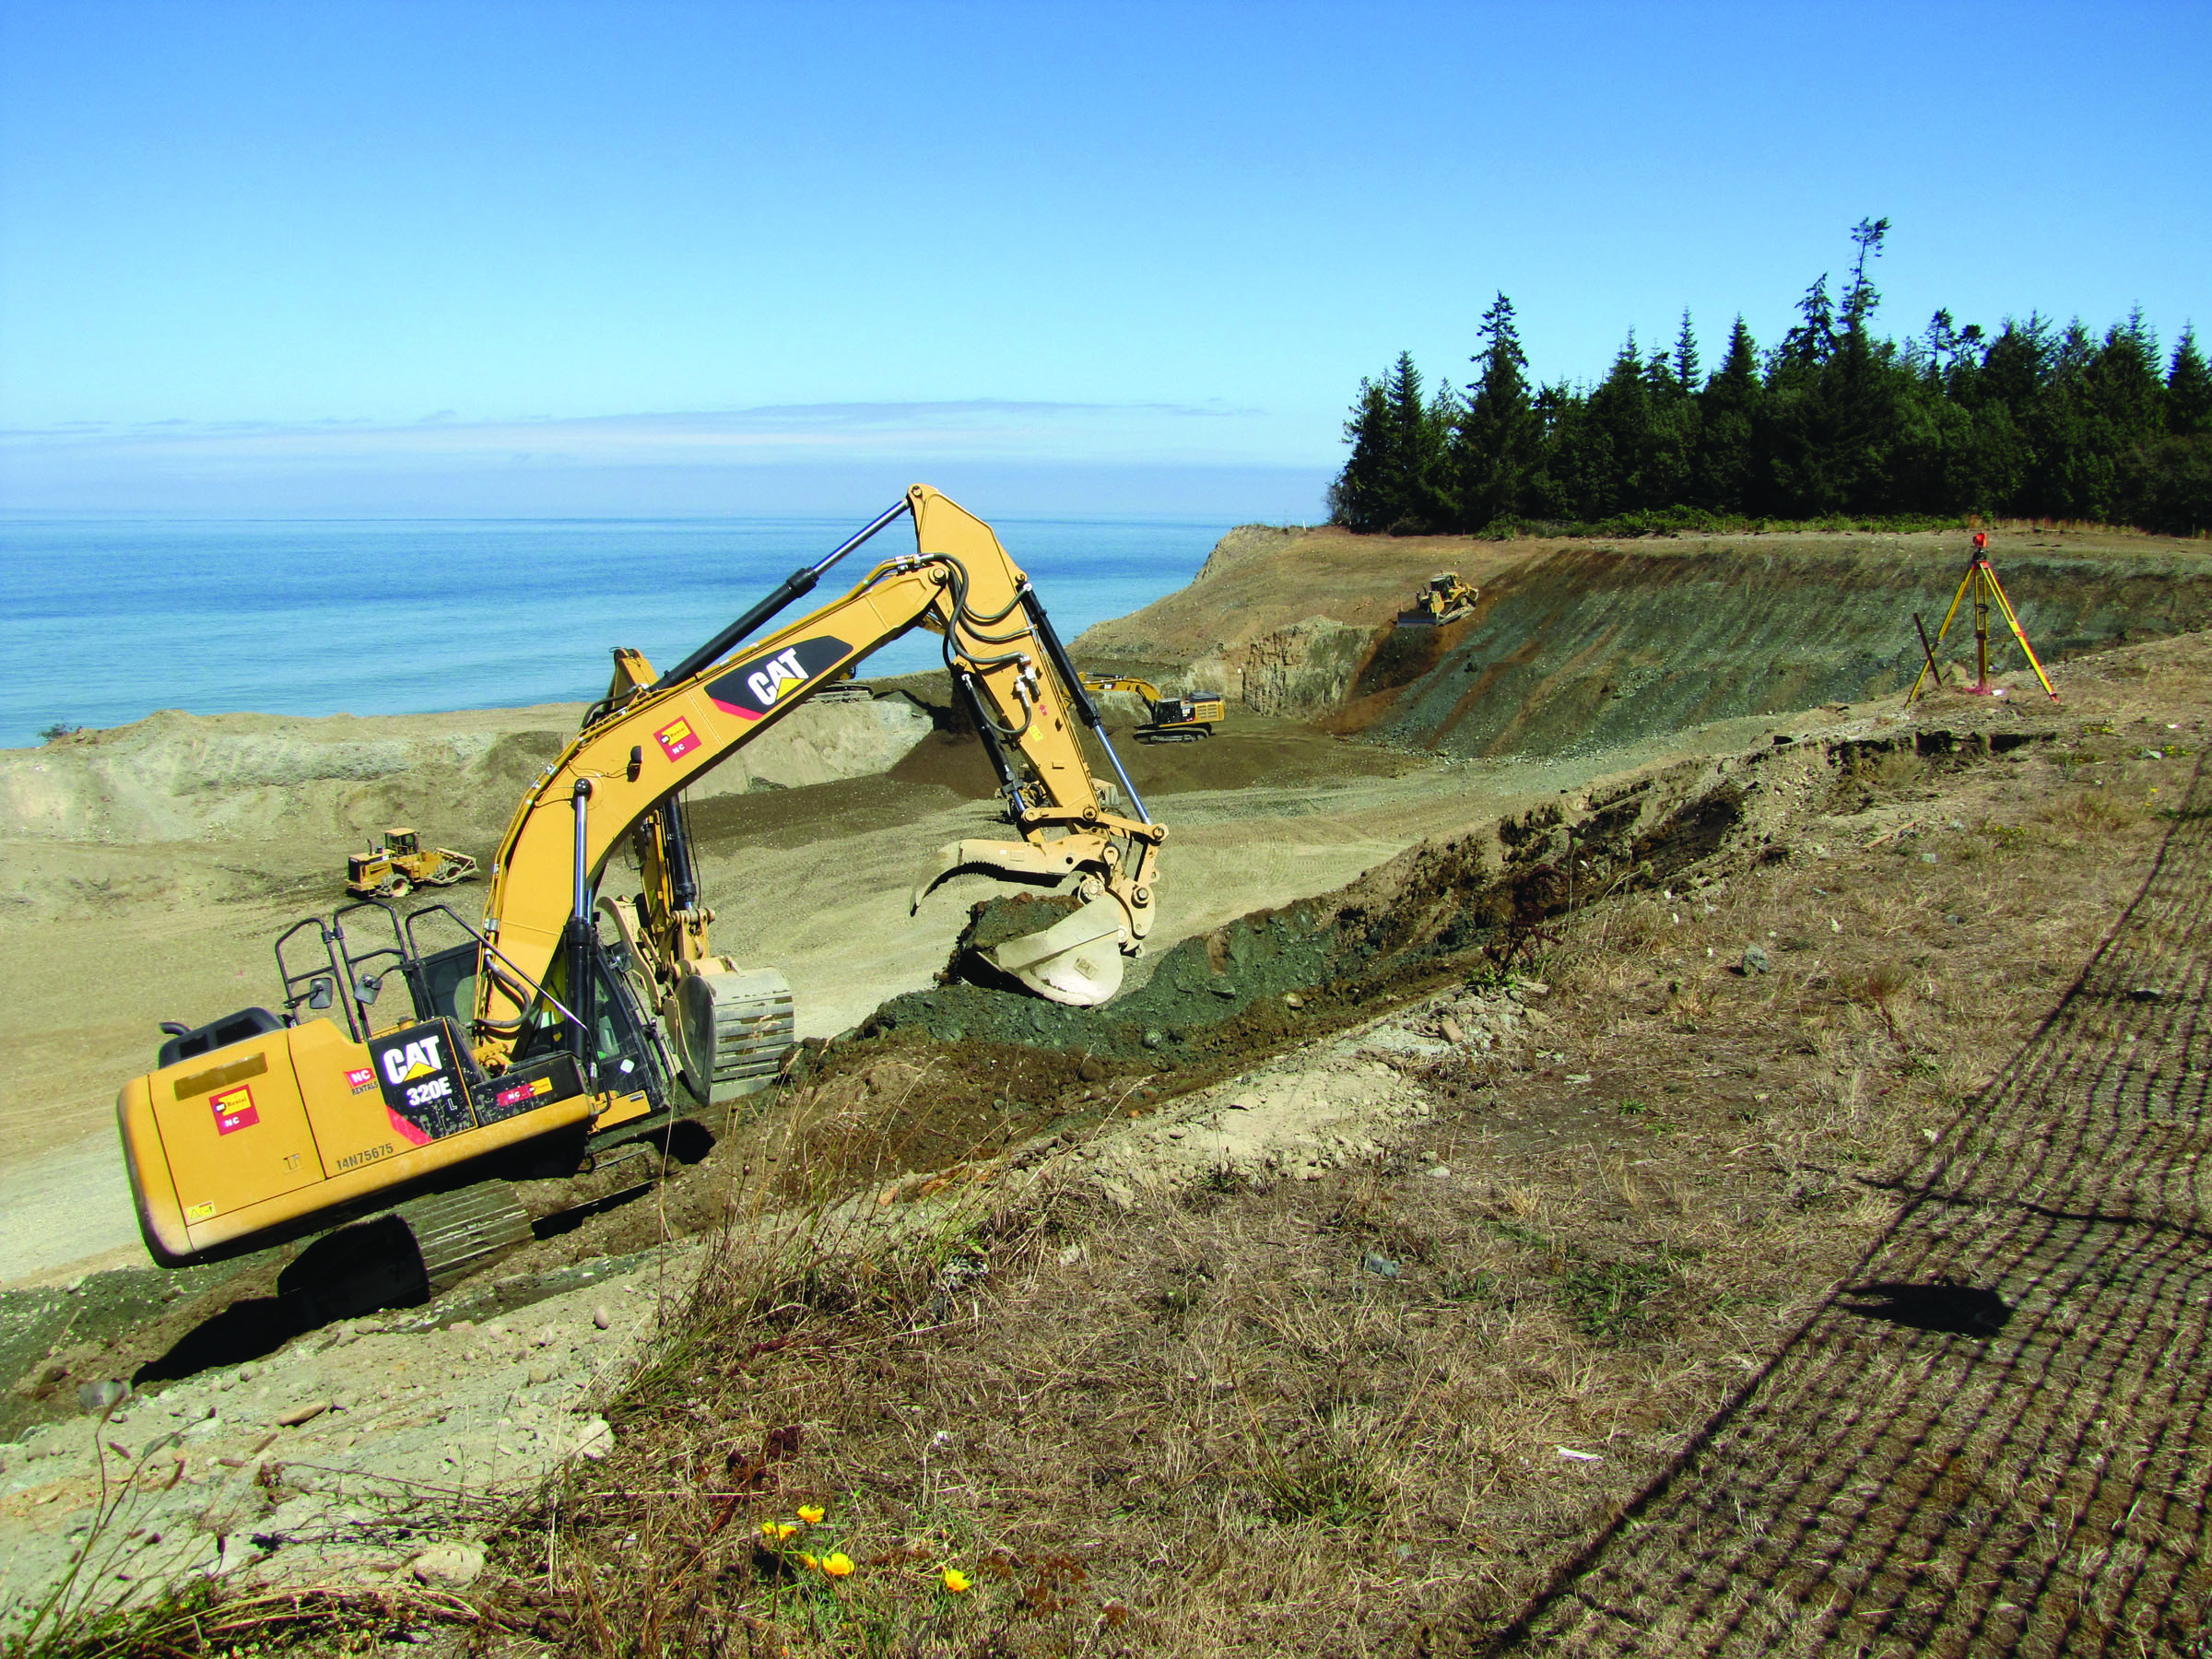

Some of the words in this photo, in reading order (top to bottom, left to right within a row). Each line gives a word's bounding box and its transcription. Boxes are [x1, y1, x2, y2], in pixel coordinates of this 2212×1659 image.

[747, 647, 809, 706] CAT
[672, 743, 686, 755] NC
[383, 1035, 442, 1084] CAT
[350, 1069, 371, 1083] NC
[351, 1081, 379, 1095] RENTALS
[406, 1076, 453, 1107] 320E
[508, 1091, 521, 1100] NC
[448, 1098, 458, 1111] L
[224, 1116, 240, 1127] NC
[336, 1143, 394, 1171] 14N75675
